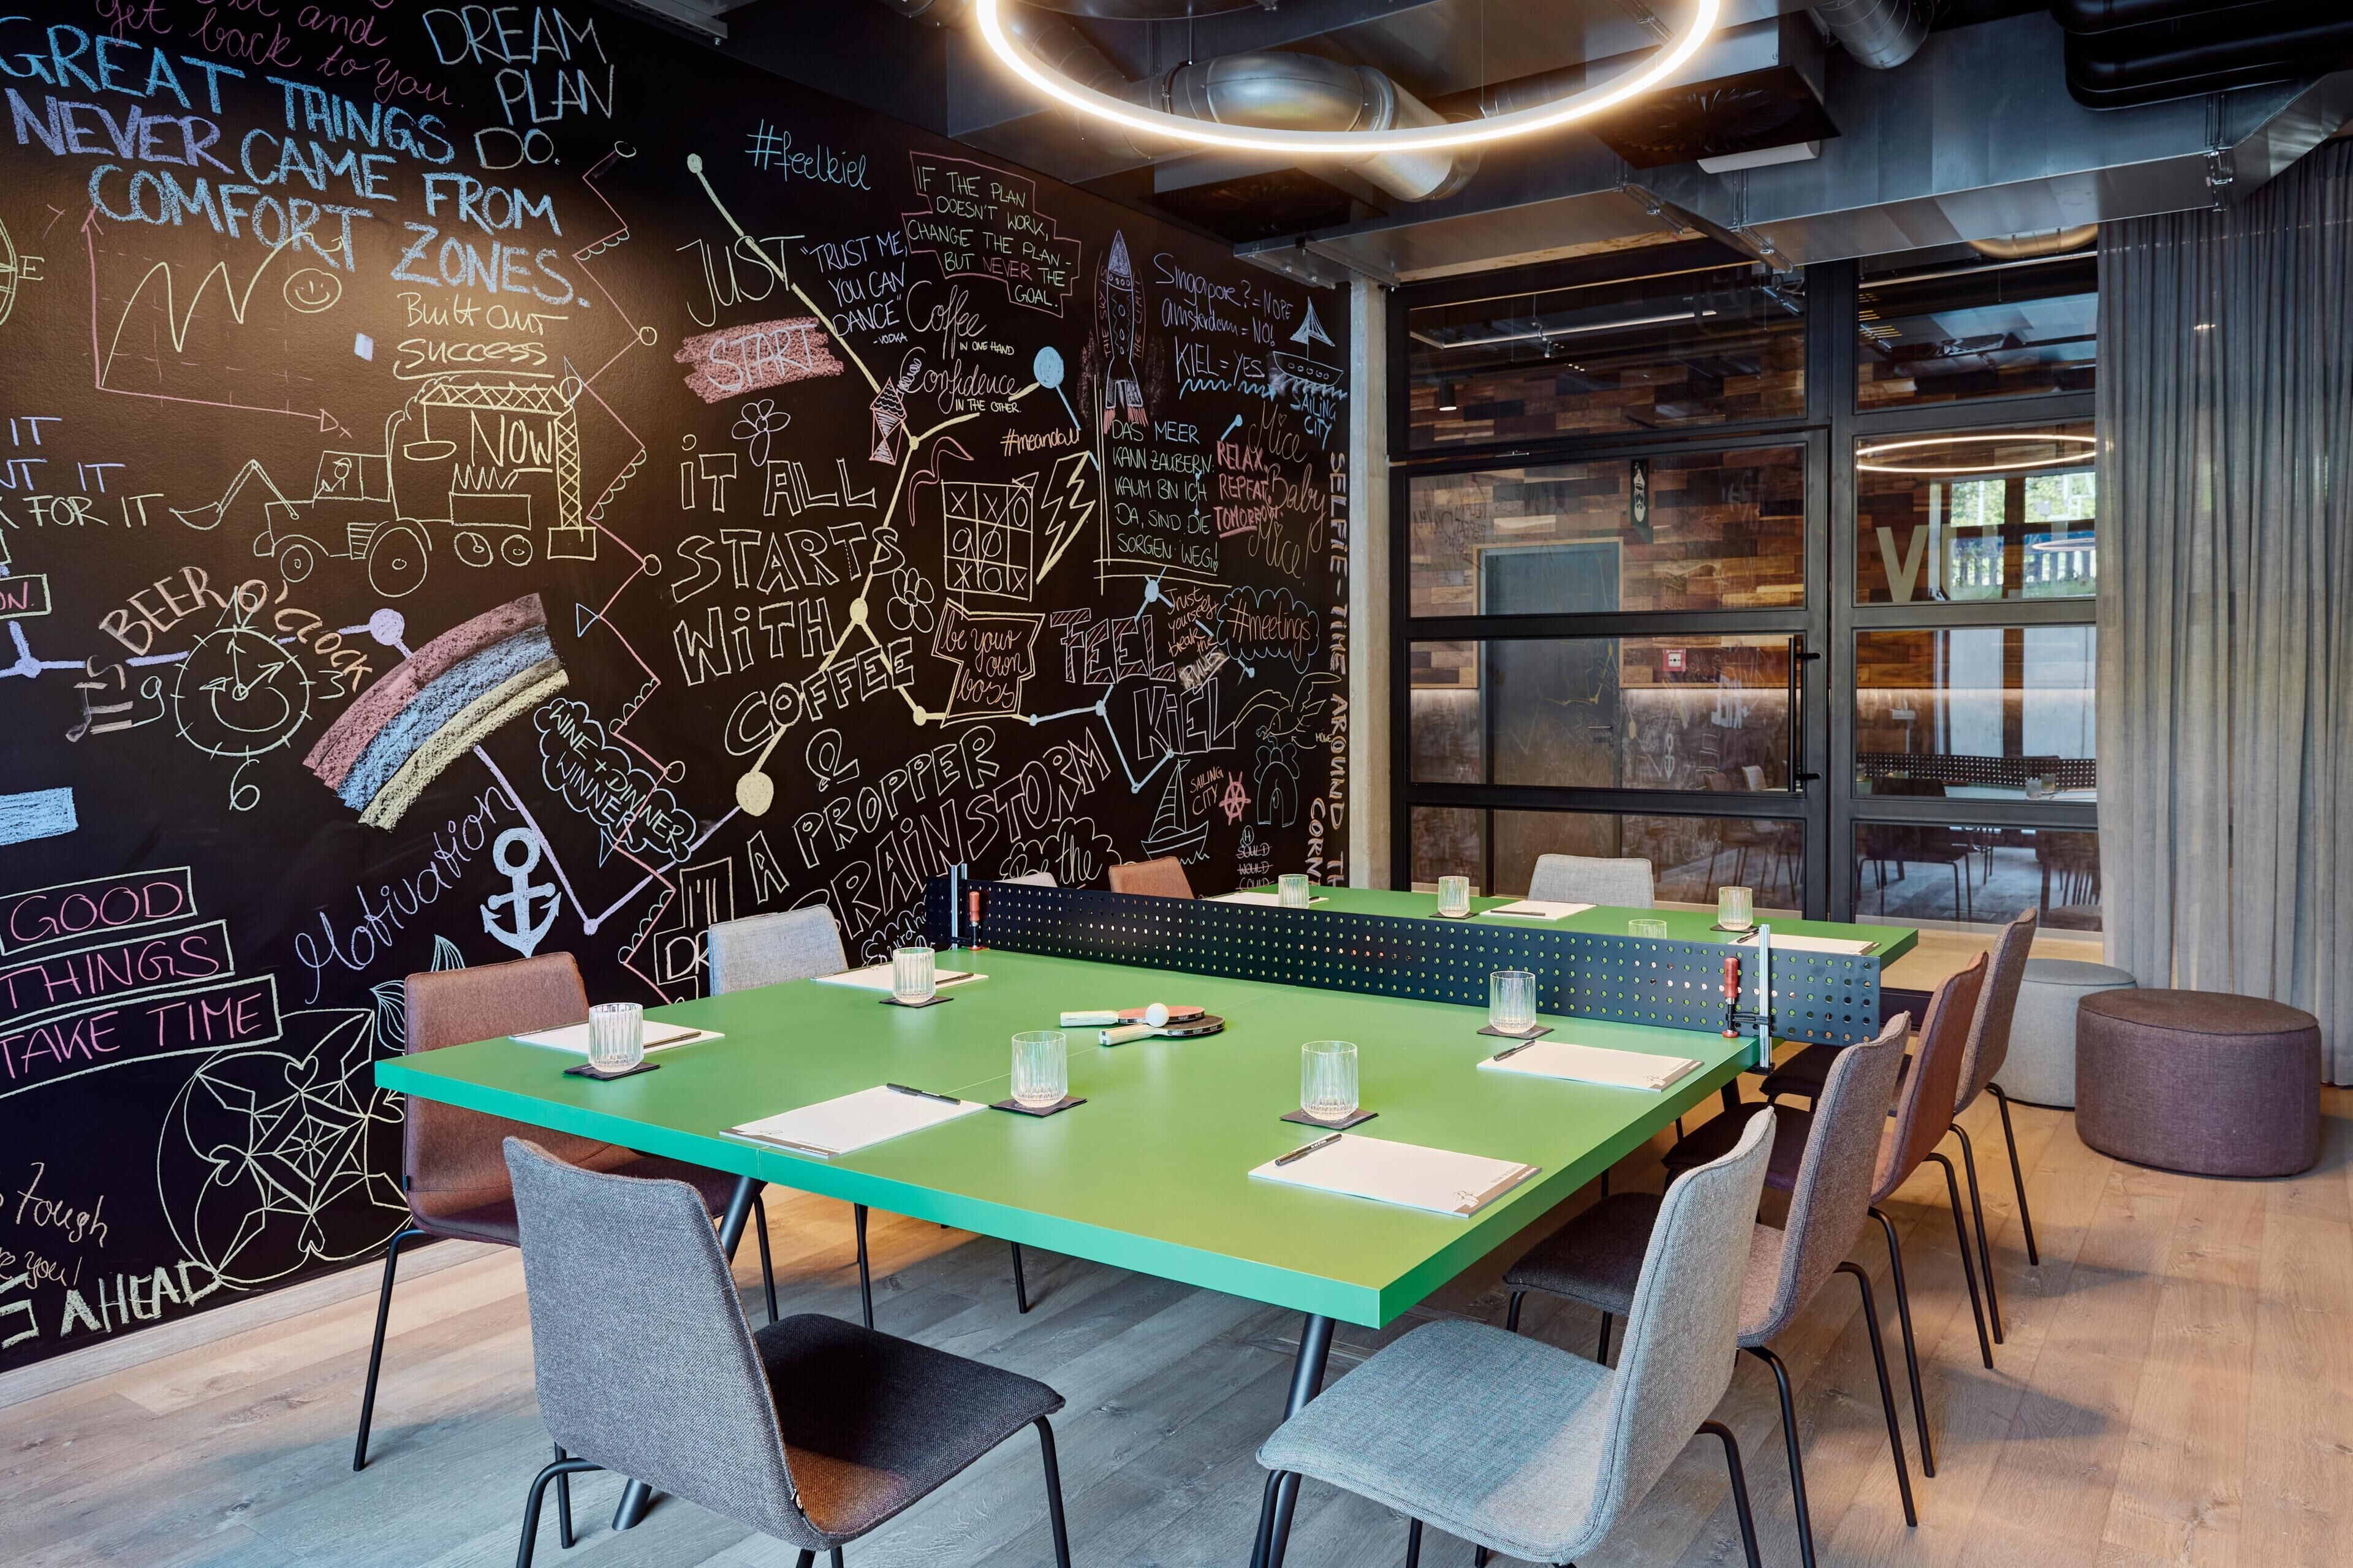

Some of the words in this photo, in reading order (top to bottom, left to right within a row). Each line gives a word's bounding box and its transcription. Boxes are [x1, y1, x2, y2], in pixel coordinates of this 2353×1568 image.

[189, 7, 301, 67] back
[317, 45, 369, 75] to
[298, 6, 387, 46] and
[423, 5, 607, 64] DREAM
[0, 17, 245, 114] GREAT
[265, 75, 455, 164] THINGS
[495, 64, 615, 125] PLAN
[4, 88, 235, 175] NEVER
[241, 129, 397, 201] CAME
[422, 172, 562, 237] FROM
[474, 127, 560, 169] DO.
[745, 119, 871, 190] #feelkiel
[917, 166, 936, 191] IF
[946, 172, 980, 197] THE
[990, 183, 1026, 208] PLAN
[88, 164, 373, 272] COMFORT
[390, 221, 591, 306] ZONES.
[877, 230, 907, 257] ME,
[907, 219, 974, 247] CHANGE
[982, 232, 1014, 254] THE
[1023, 242, 1060, 266] PLAN
[937, 196, 998, 220] DOESN'T
[1007, 211, 1048, 241] WORK,
[676, 235, 805, 327] JUST
[828, 279, 866, 307] YOU
[869, 262, 905, 300] CAN
[944, 252, 975, 271] BUT
[982, 257, 1033, 281] NEVER
[1037, 267, 1066, 286] THE
[397, 292, 481, 327] Built
[906, 280, 987, 360] Coffee
[1015, 285, 1058, 307] GOAL.
[1264, 289, 1294, 321] NOPE
[707, 324, 818, 392] START
[960, 341, 968, 350] IN
[972, 341, 988, 350] ONE
[990, 341, 1015, 355] HAND
[1252, 316, 1275, 347] NO!
[901, 347, 1021, 414] Confidence
[1175, 336, 1219, 383] KIEL
[1233, 350, 1265, 386] YES
[10, 417, 63, 446] IT
[955, 399, 964, 411] IN
[968, 398, 986, 411] THE
[990, 402, 1022, 414] OTHER.
[1112, 419, 1143, 441] DAS
[1154, 421, 1200, 444] MEER
[470, 409, 553, 467] NOW
[1113, 447, 1146, 469] KANN
[1304, 417, 1332, 451] CITY
[78, 461, 126, 493] IT
[763, 458, 877, 516] ALL
[1115, 476, 1151, 499] KAUM
[1184, 480, 1207, 502] ICH
[22, 495, 109, 526] FOR
[121, 493, 164, 528] IT
[1148, 510, 1181, 531] SIND
[1188, 514, 1211, 534] DIE
[671, 521, 906, 604] STARTS
[1118, 533, 1171, 559] SORGEN
[98, 566, 228, 656] BEER
[1164, 586, 1203, 615] Trust
[941, 610, 967, 652] be
[971, 626, 1022, 673] your
[1050, 608, 1176, 685] FEEL
[1227, 598, 1311, 662] #meetings
[957, 668, 1015, 708] boss
[986, 653, 1027, 677] own
[725, 637, 914, 756] COFFEE
[549, 704, 598, 760] WINE
[605, 768, 684, 852] DINNER
[1190, 767, 1224, 793] SAILING
[1329, 693, 1348, 830] AROUND
[556, 751, 635, 844] WINNER
[747, 830, 790, 904] A
[792, 725, 1000, 869] PROPPER
[1192, 783, 1218, 815] CITY
[1056, 831, 1102, 884] the
[1305, 798, 1326, 887] CORN
[10, 882, 183, 941] GOOD
[295, 786, 517, 1004] Motivation
[0, 936, 219, 1009] THINGS
[0, 1010, 120, 1078] TAKE
[146, 993, 262, 1046] TIME
[61, 1259, 222, 1338] AHEAD
